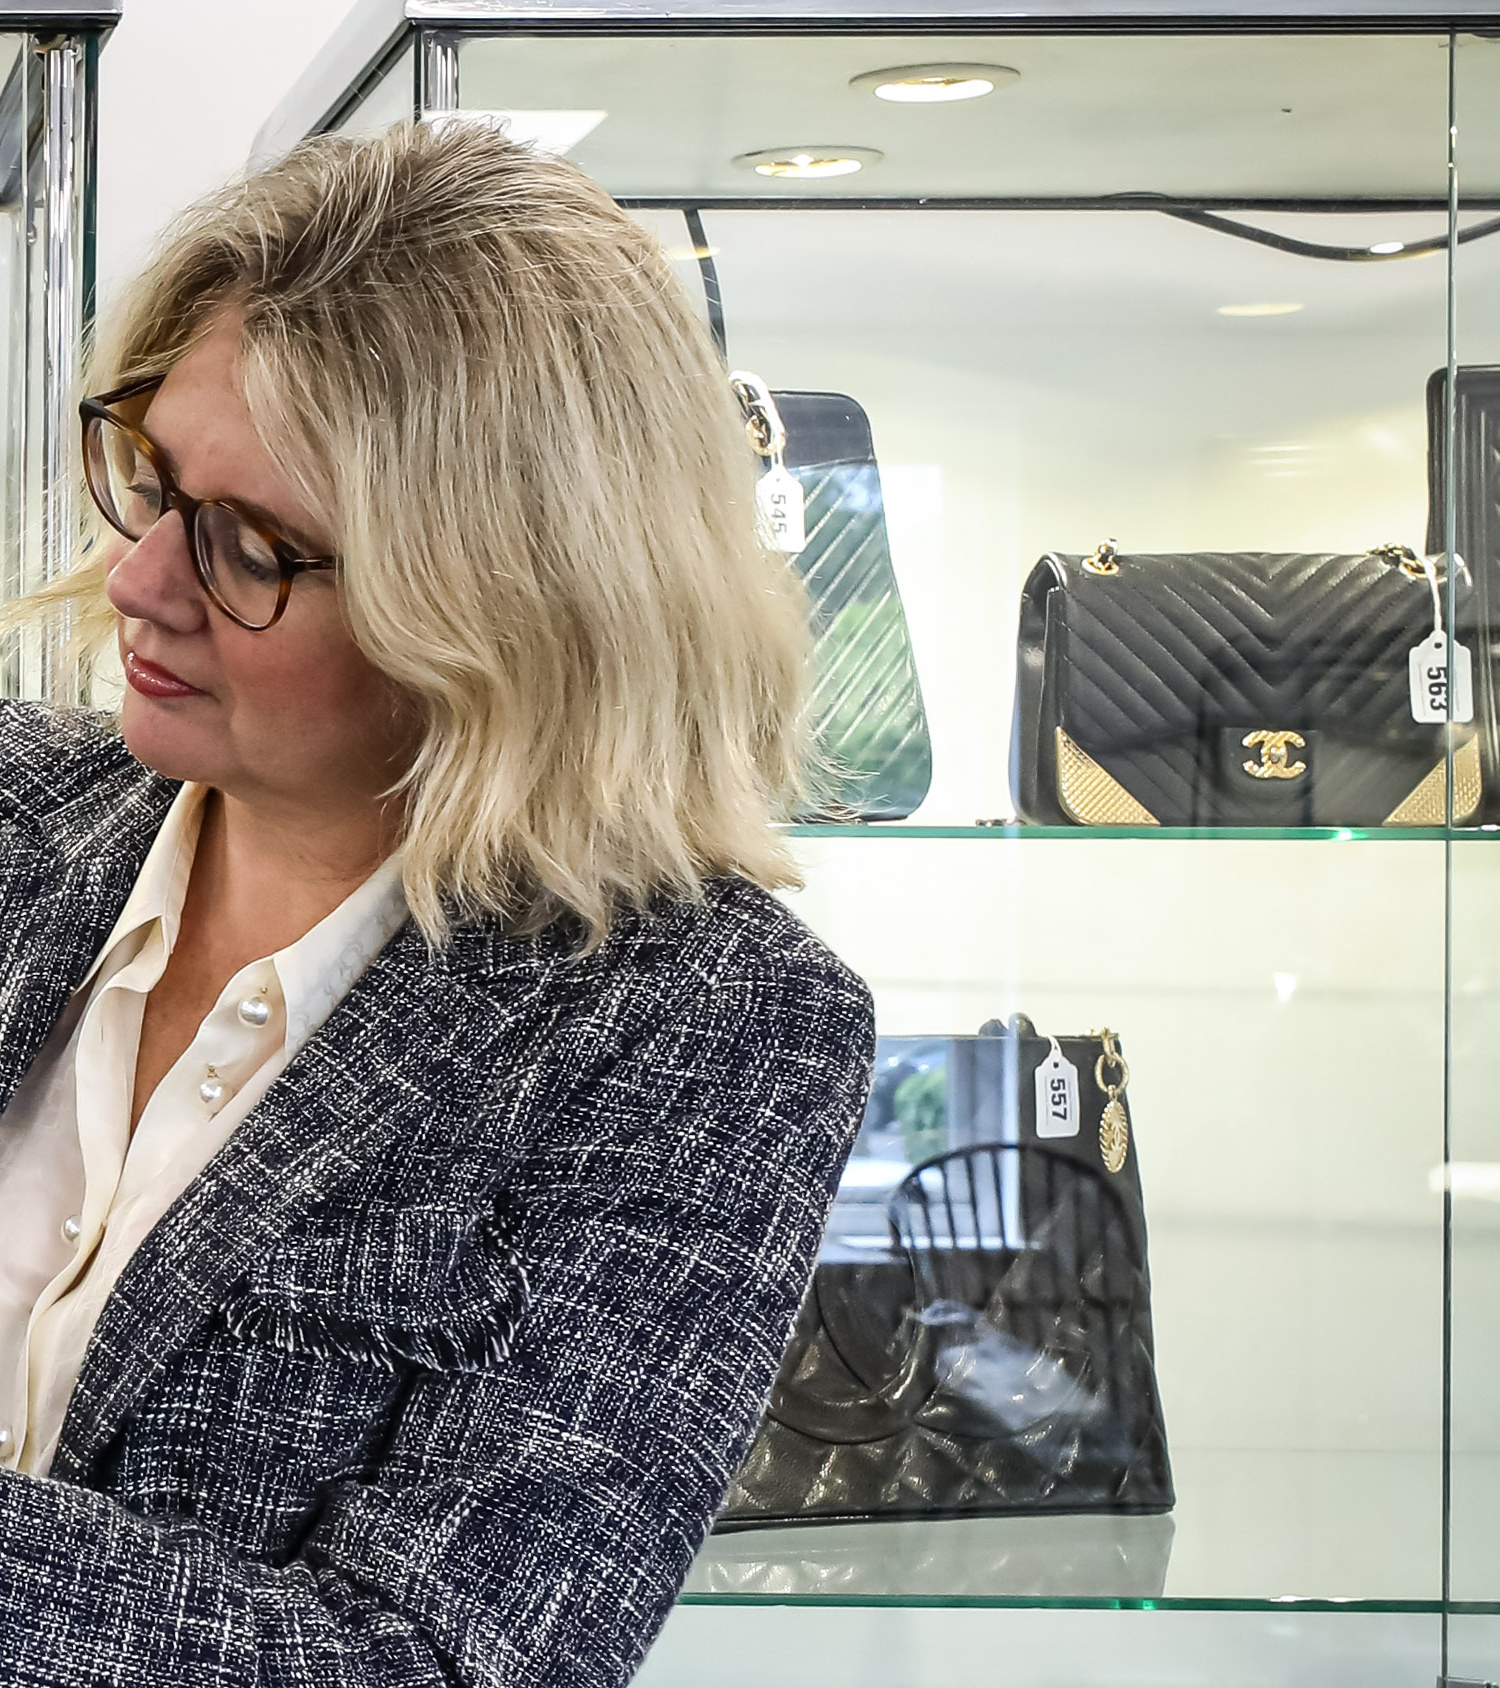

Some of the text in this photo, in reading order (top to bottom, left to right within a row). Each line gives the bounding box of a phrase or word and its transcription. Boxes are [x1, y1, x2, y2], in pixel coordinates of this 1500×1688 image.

[770, 494, 787, 533] 545
[1427, 666, 1447, 711] 563
[1050, 1078, 1068, 1121] 557
